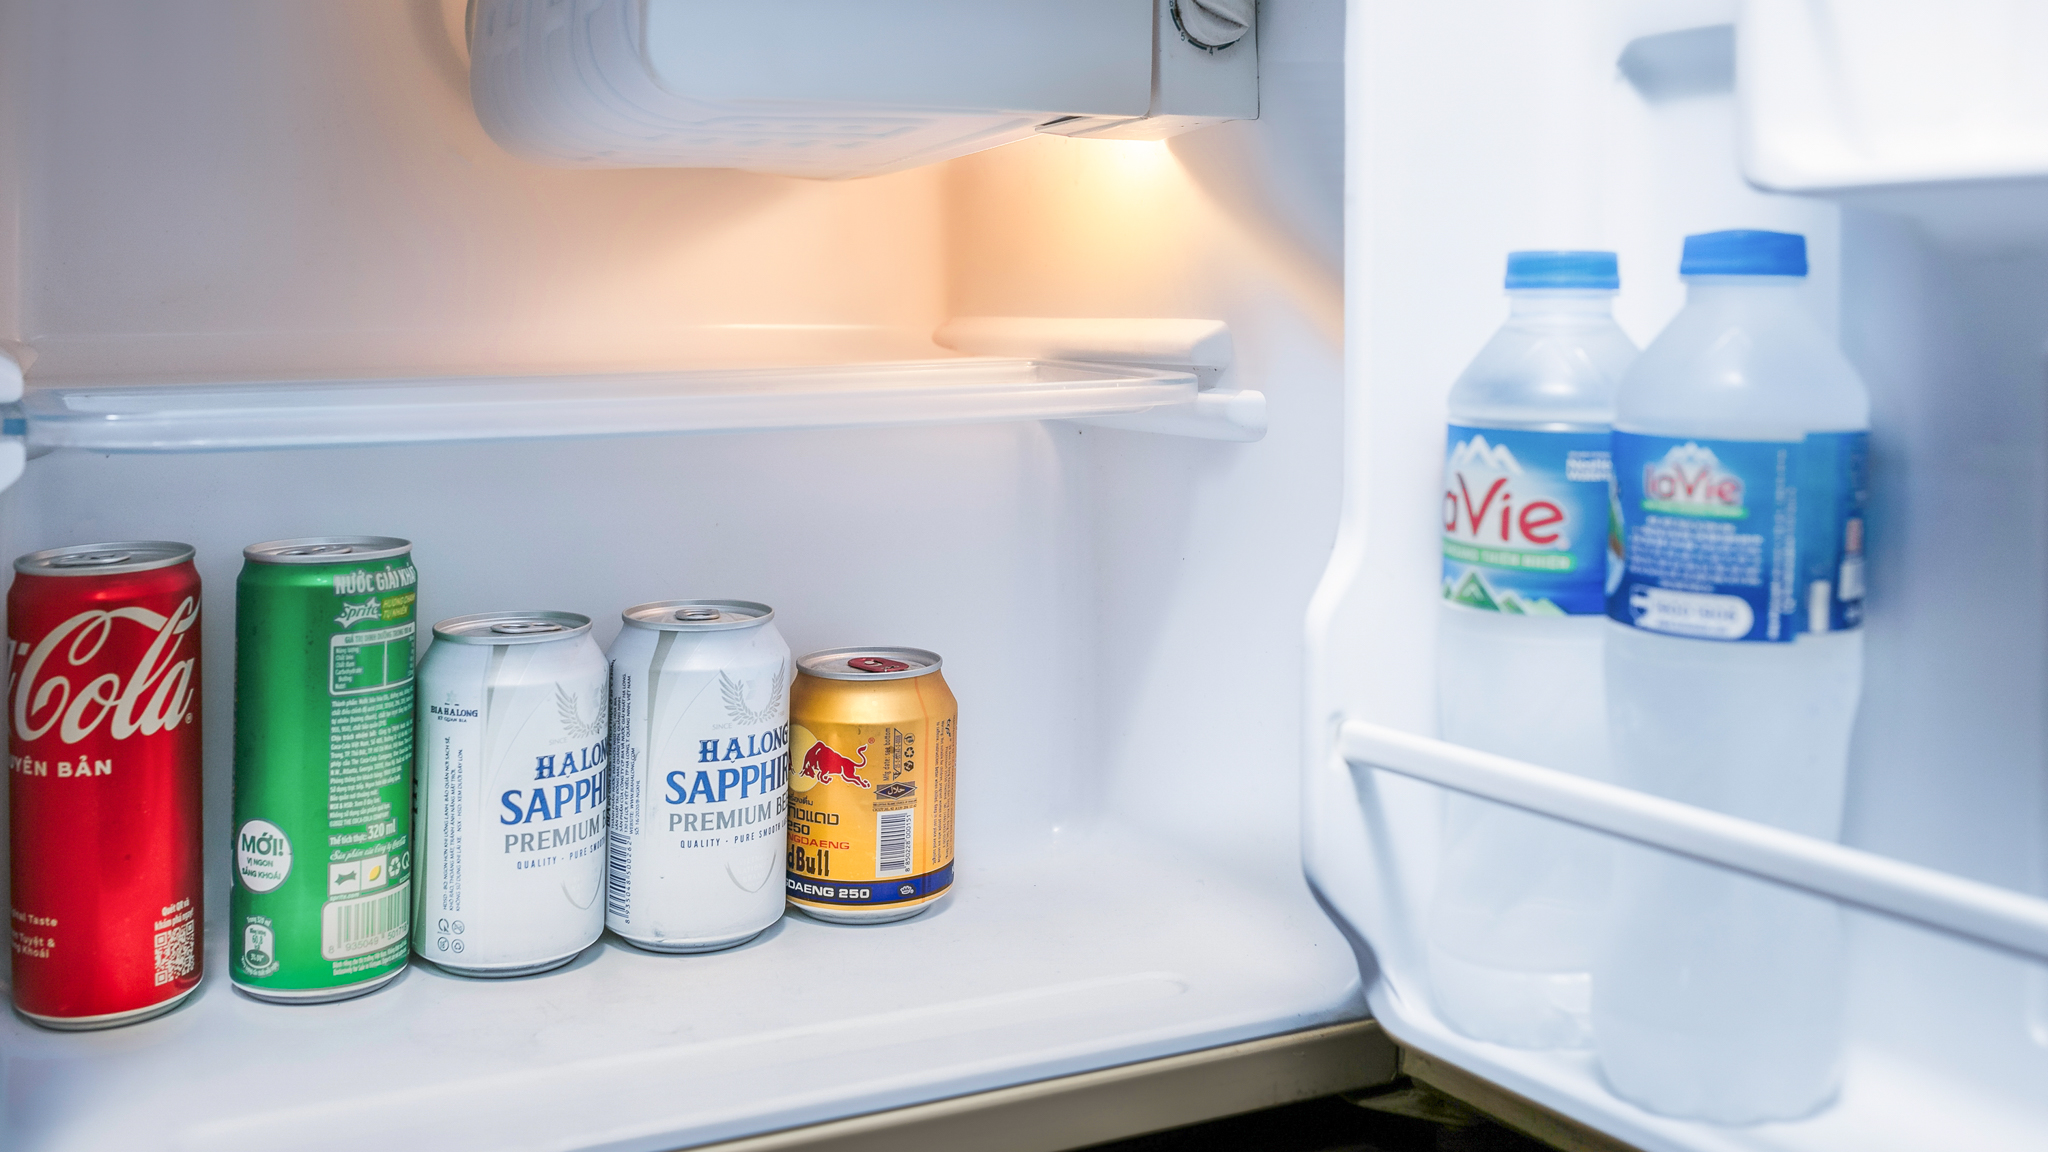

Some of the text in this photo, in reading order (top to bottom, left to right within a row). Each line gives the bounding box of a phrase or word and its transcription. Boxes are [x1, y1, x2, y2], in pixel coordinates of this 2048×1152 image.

[1181, 32, 1186, 41] 5
[1209, 46, 1214, 56] 4
[1443, 472, 1564, 545] aVie
[334, 569, 374, 595] NƯỚC
[376, 565, 399, 591] GIẢI
[340, 603, 379, 621] Sprite
[15, 596, 200, 744] Cola
[712, 722, 733, 730] SINCE
[57, 755, 112, 778] BẢN
[534, 737, 608, 780] HALON
[665, 751, 788, 805] SAPPHIR
[500, 769, 608, 825] SAPPHI
[669, 801, 772, 832] PREMIUM
[788, 820, 810, 835] 250
[368, 818, 396, 839] 320 ml
[504, 814, 600, 854] PREMIUM
[680, 823, 781, 848] QUALITY PURE SMOOTH
[242, 832, 284, 856] MỚI!
[788, 833, 850, 850] NGDAENG
[517, 856, 557, 870] QUALITY
[569, 847, 587, 860] PURE
[787, 844, 829, 877] dBull
[839, 889, 870, 898] 250
[28, 914, 58, 927] Taste
[47, 937, 55, 948] &
